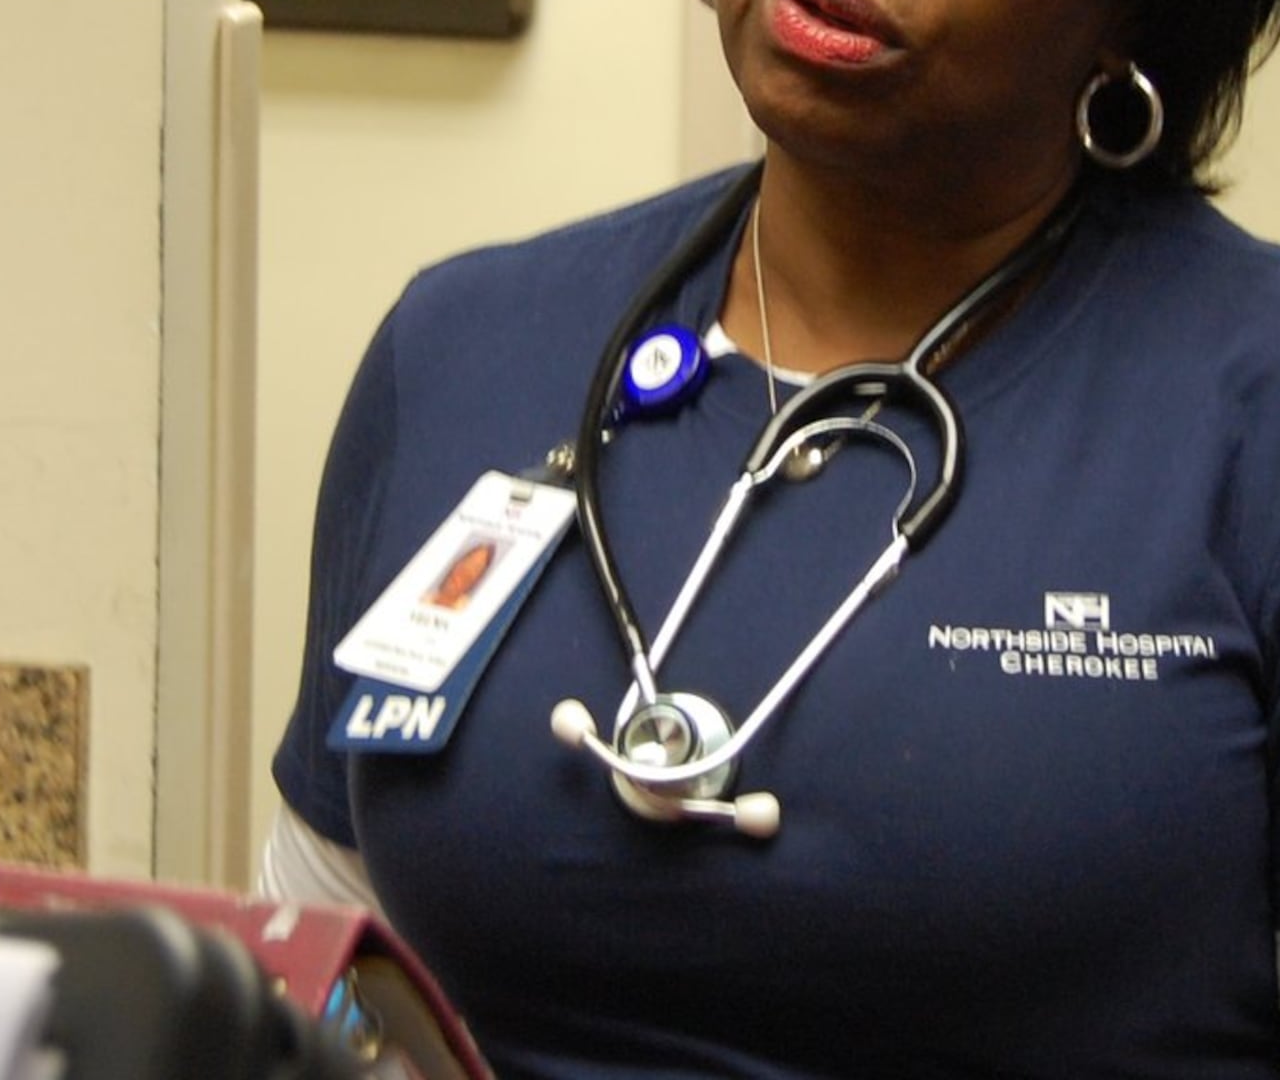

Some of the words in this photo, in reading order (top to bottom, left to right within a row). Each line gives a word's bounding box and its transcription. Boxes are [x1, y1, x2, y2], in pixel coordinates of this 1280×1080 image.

[928, 624, 1087, 654] NORTHSIDE
[1000, 651, 1159, 681] CHEROKEE
[346, 694, 446, 740] LPN
